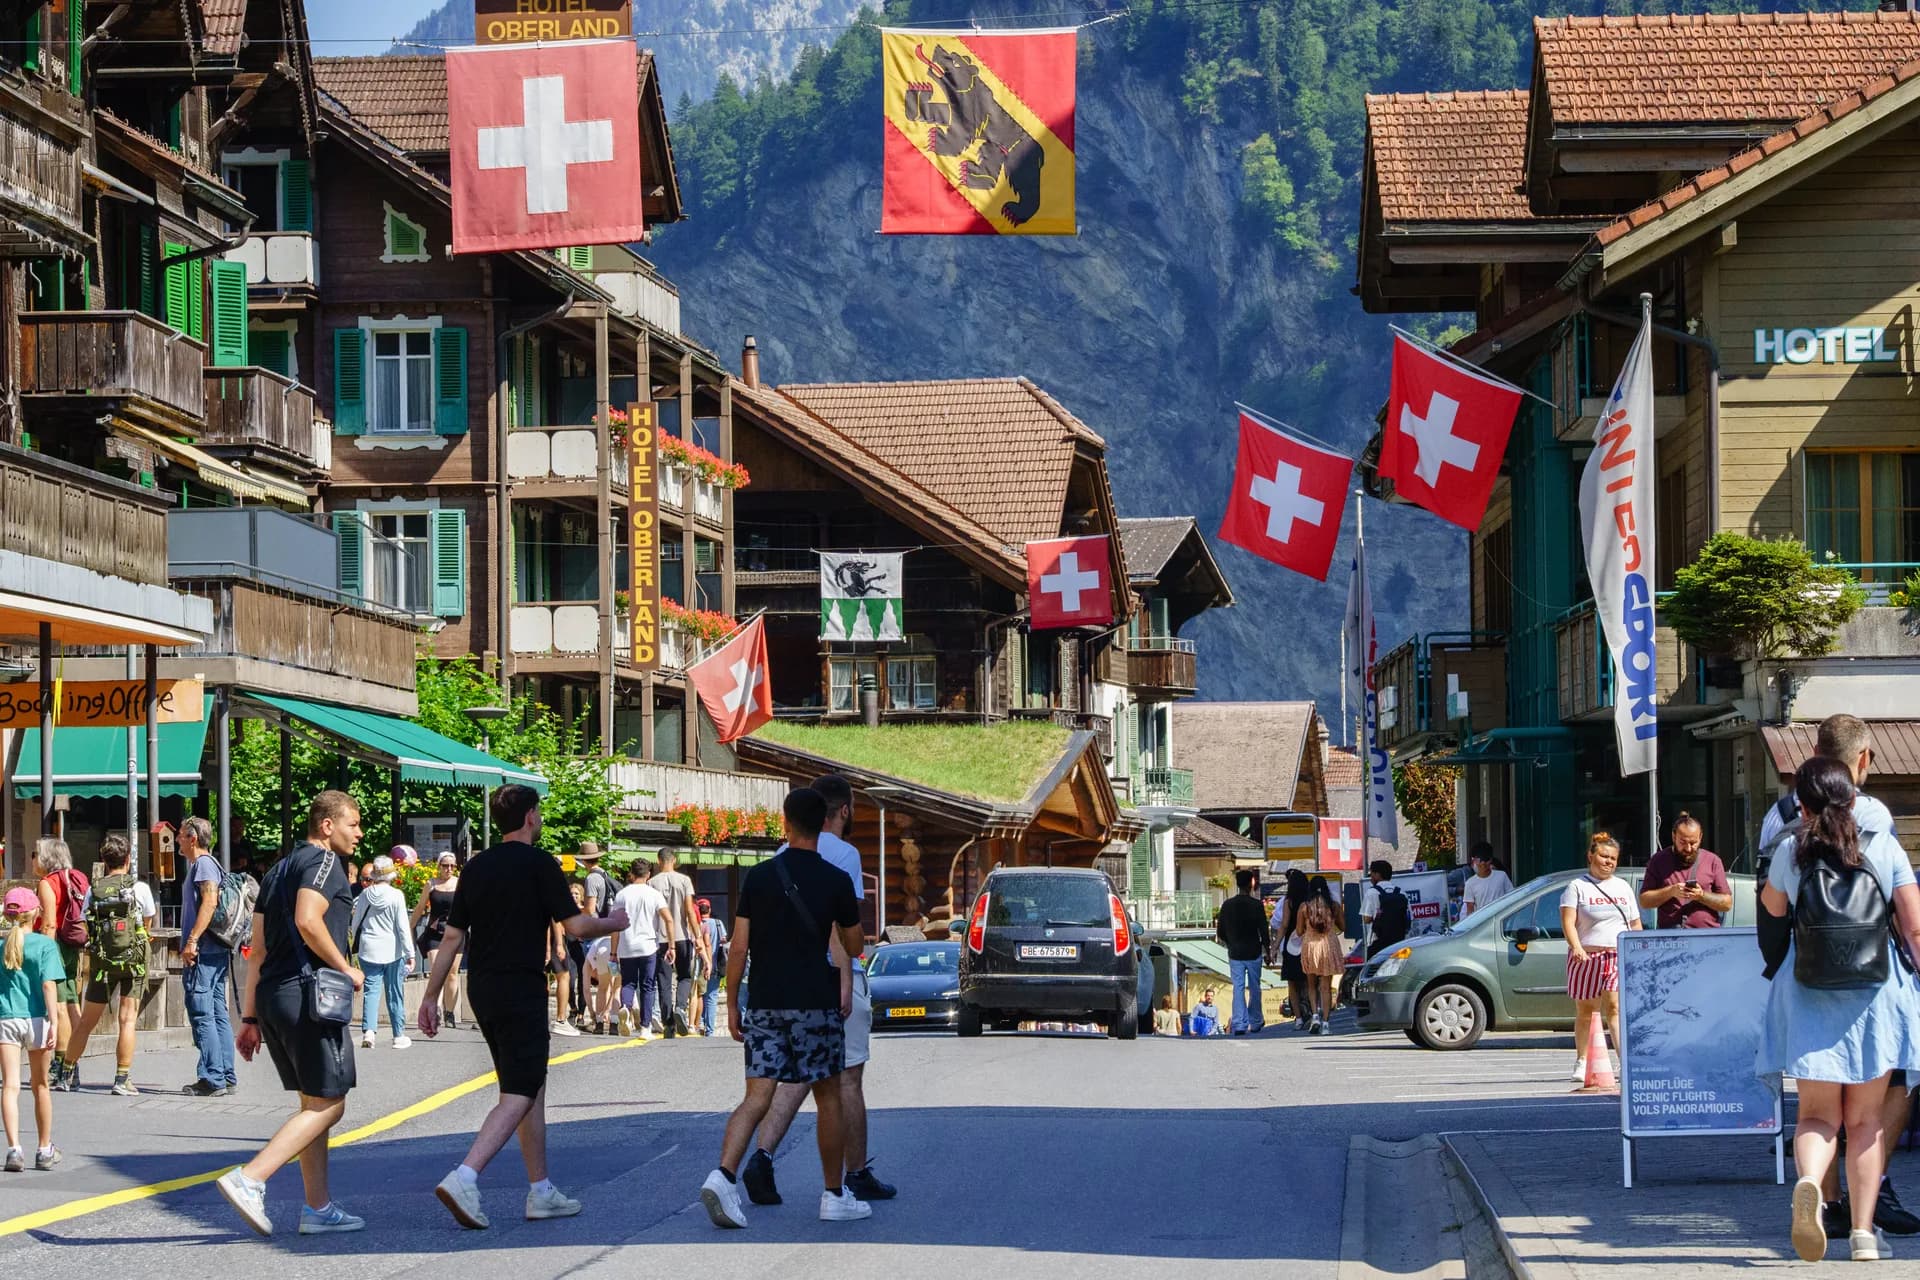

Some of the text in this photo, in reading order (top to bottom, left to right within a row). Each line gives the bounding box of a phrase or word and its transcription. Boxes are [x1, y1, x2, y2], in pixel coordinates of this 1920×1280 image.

[516, 0, 596, 14] HOTEL
[487, 18, 620, 41] OBERLAND
[1754, 327, 1898, 364] HOTEL
[632, 407, 655, 664] HOTEL OBERLAND
[1648, 938, 1689, 951] GLACIERS
[1632, 1077, 1694, 1090] RUNDFLÜGE
[1632, 1090, 1716, 1103] SCENIC FLIGHTS
[1633, 1102, 1744, 1115] VOLS PANORAMIQUES
